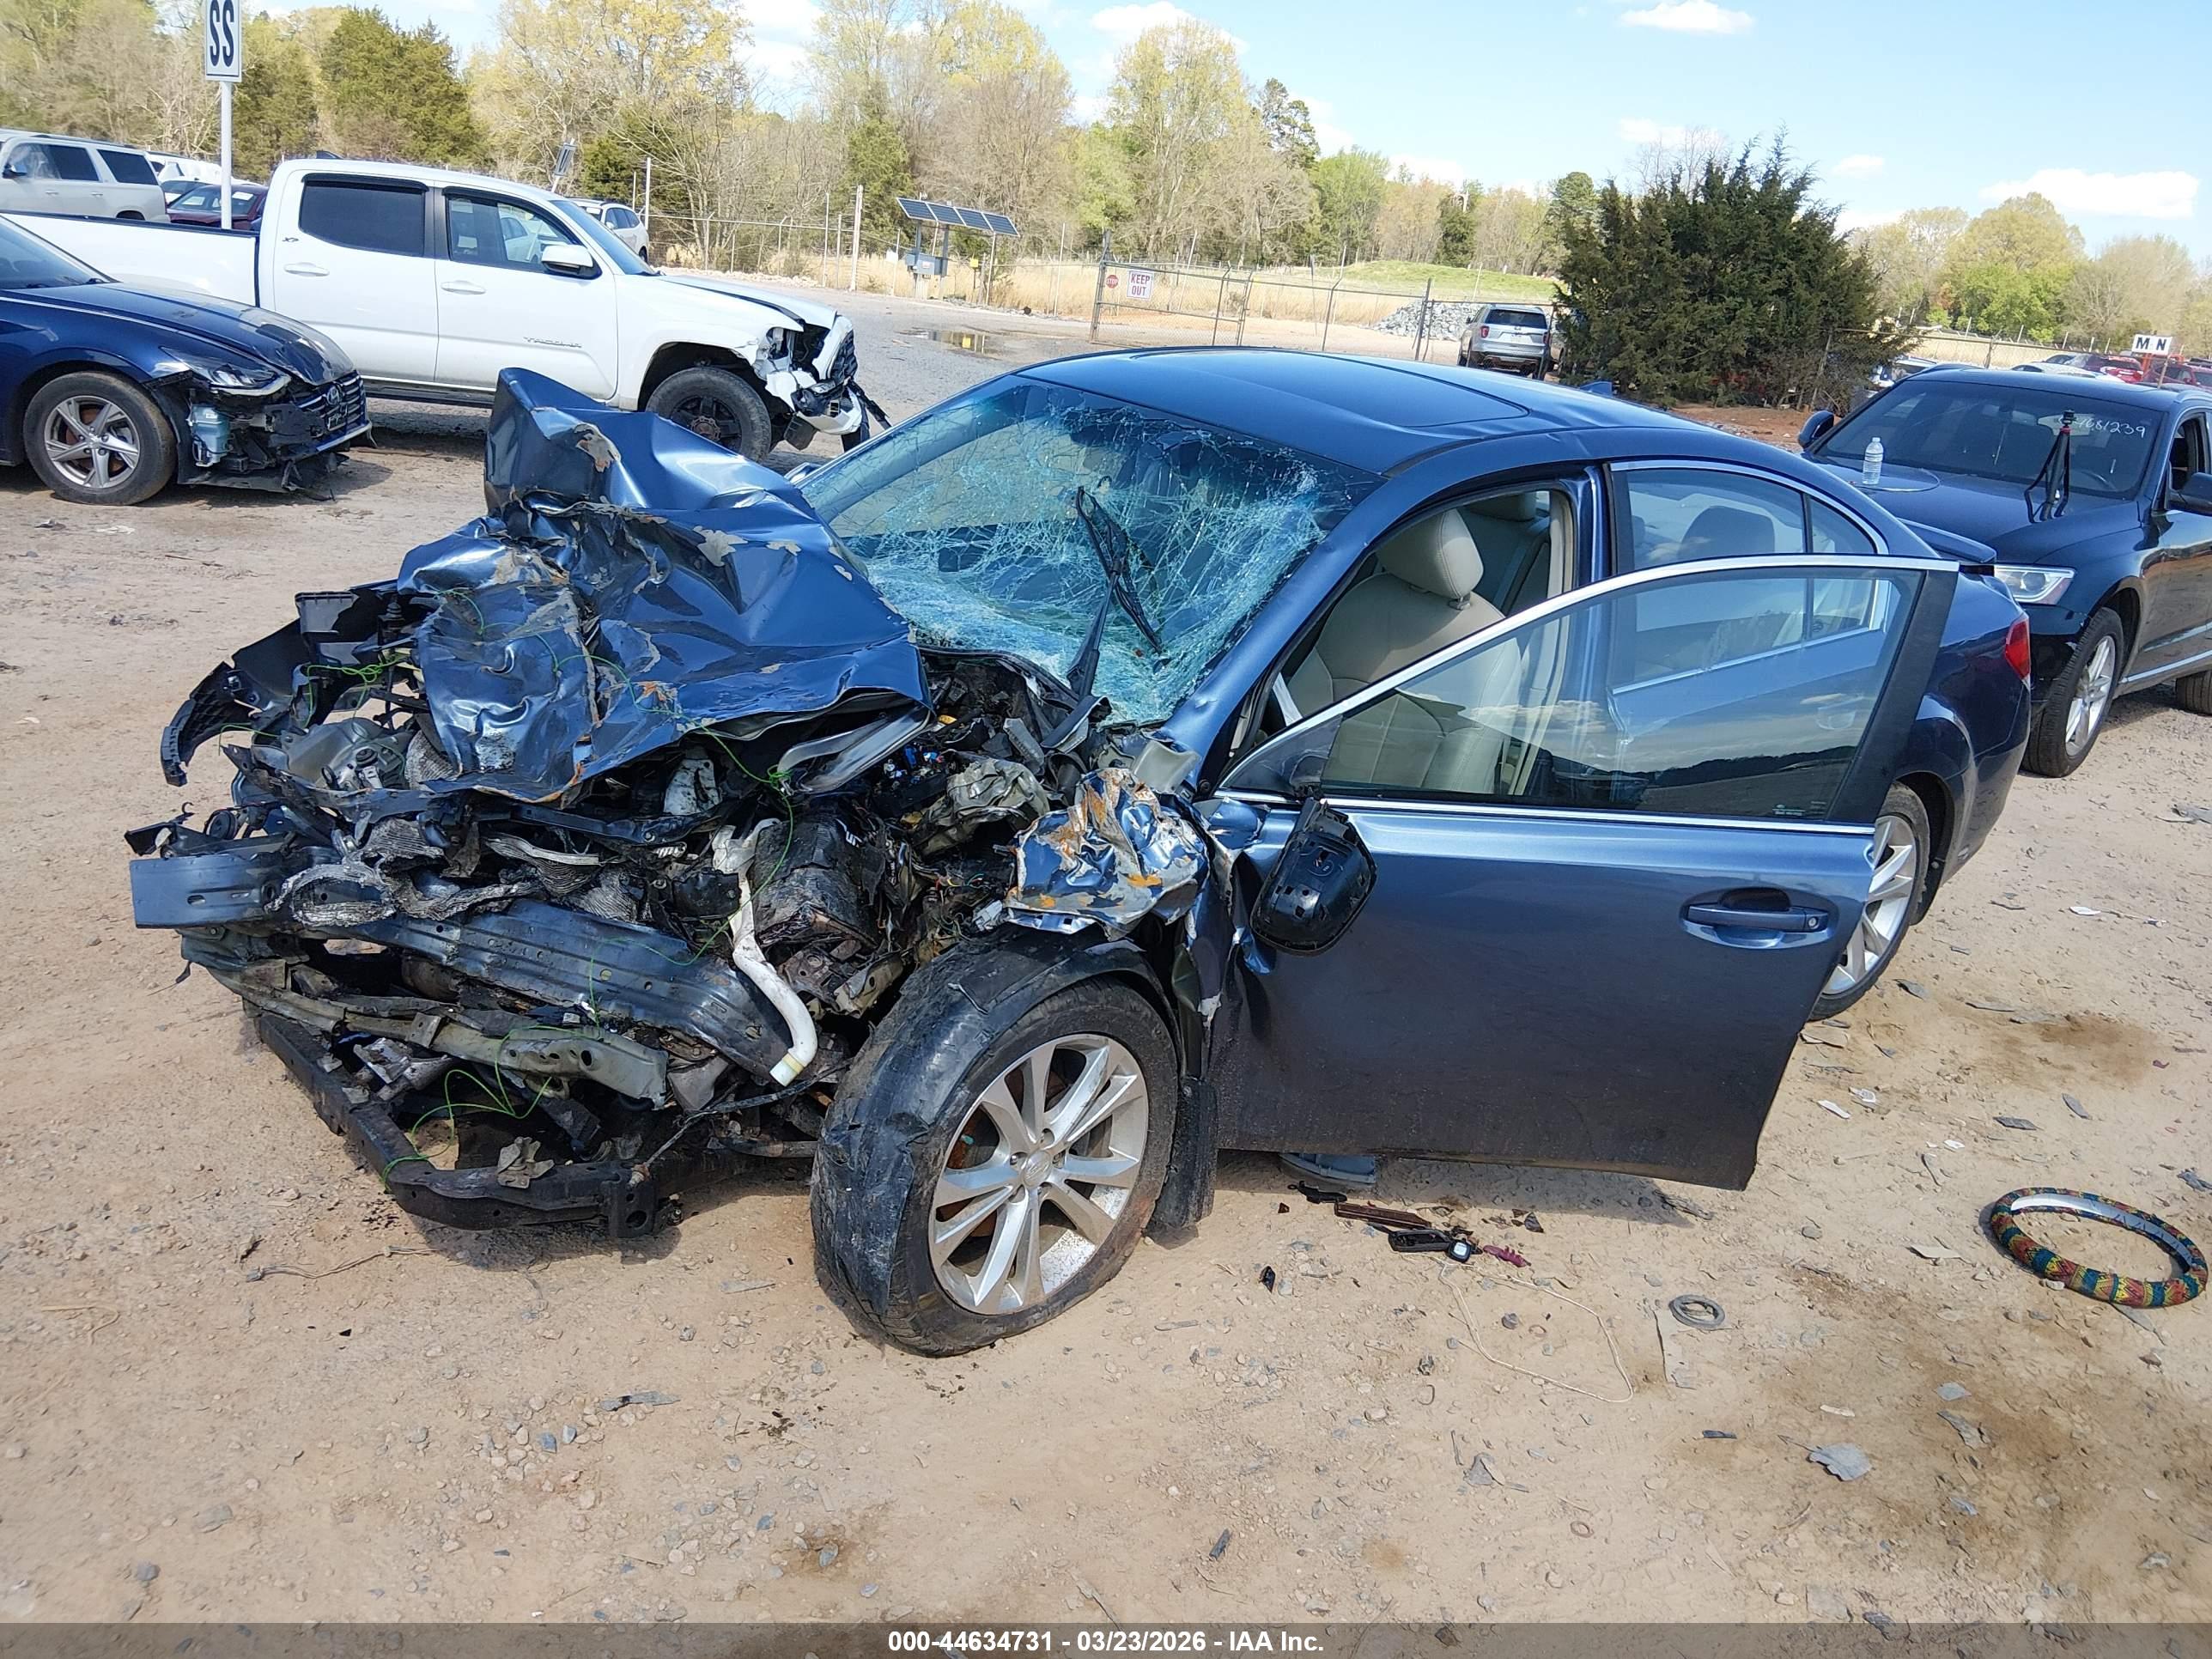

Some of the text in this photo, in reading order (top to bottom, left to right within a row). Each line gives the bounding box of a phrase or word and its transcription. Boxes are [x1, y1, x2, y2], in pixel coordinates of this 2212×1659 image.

[210, 0, 234, 67] SS
[1131, 273, 1151, 284] KEEP
[1131, 285, 1147, 295] OUT
[2136, 337, 2167, 351] M N
